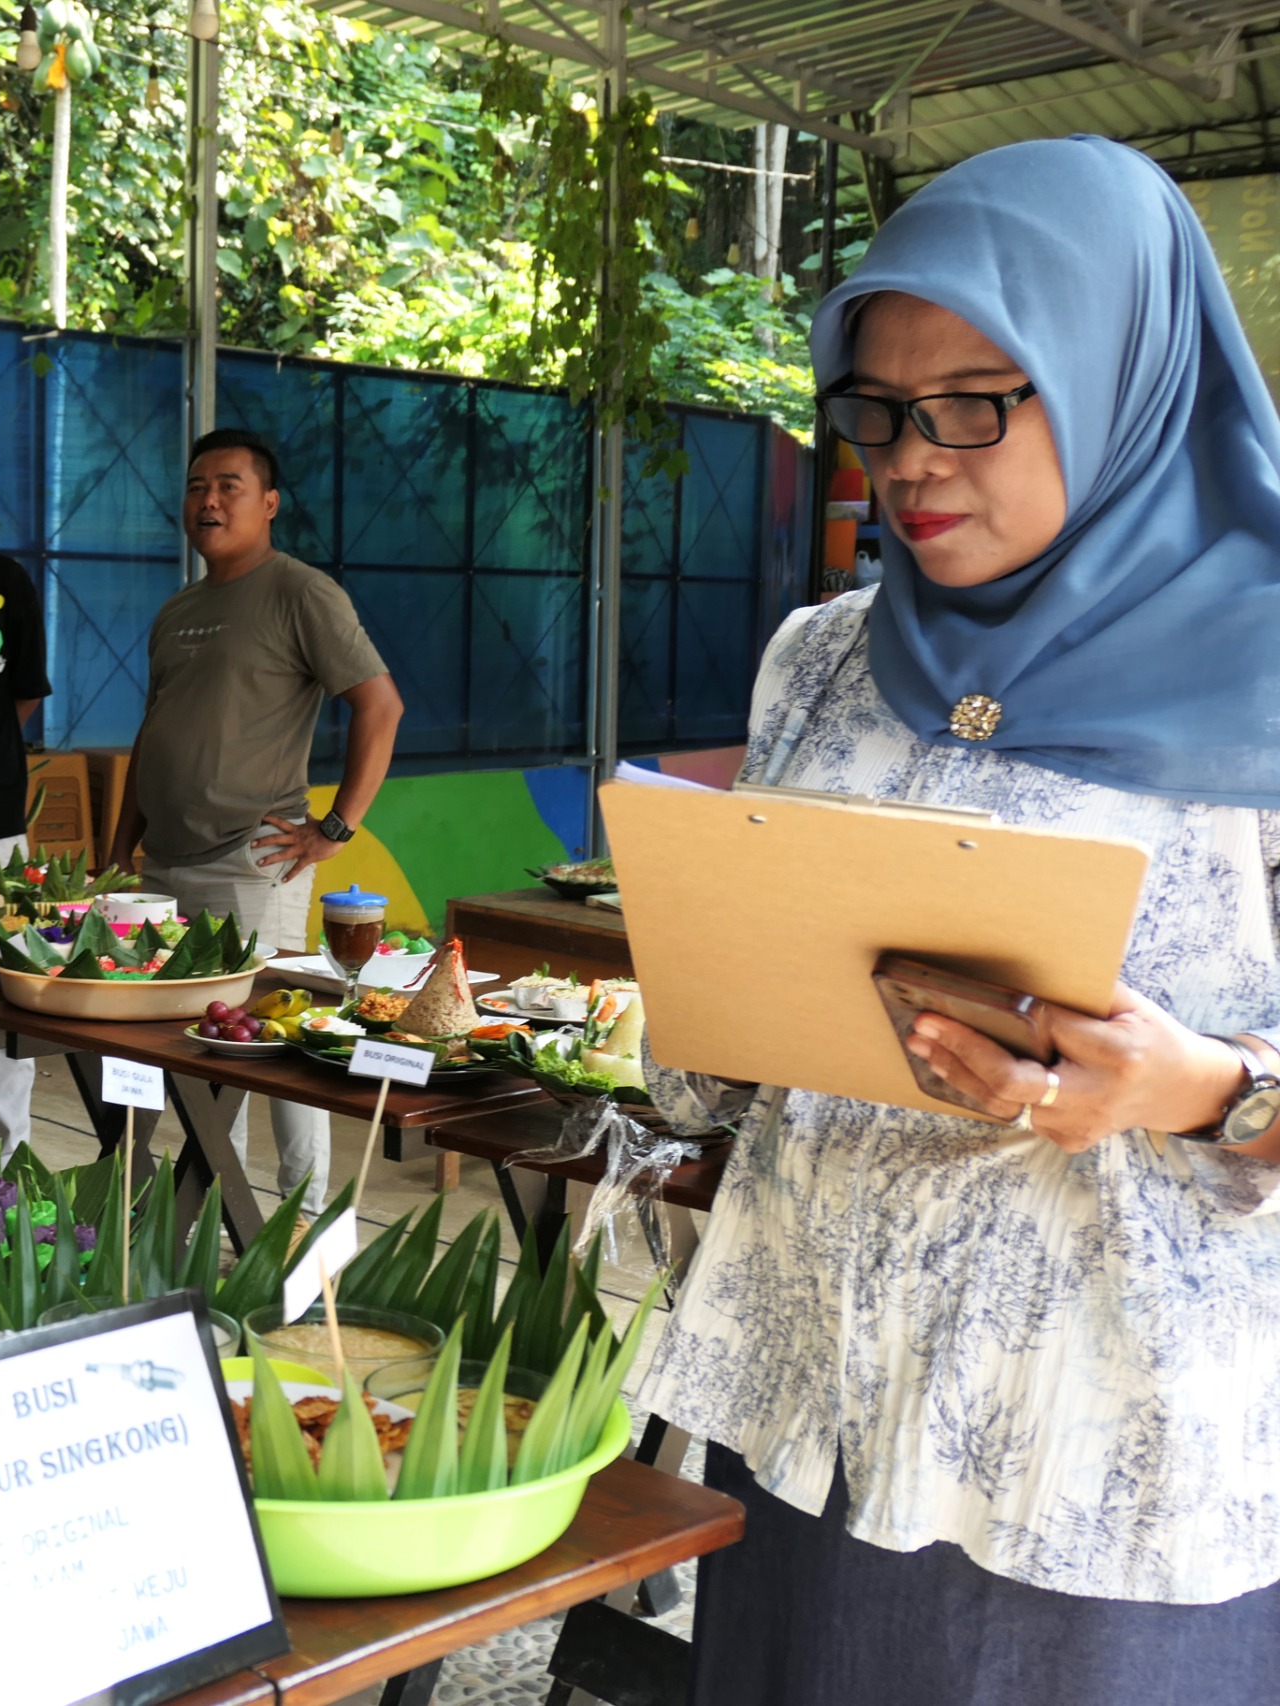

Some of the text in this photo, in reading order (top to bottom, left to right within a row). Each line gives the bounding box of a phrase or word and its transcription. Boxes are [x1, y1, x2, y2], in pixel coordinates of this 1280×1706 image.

[363, 1050, 425, 1071] BUSI ORIGINAL
[12, 1377, 80, 1419] BUSI
[39, 1412, 189, 1480] SINGKONG)
[21, 1505, 131, 1557] ORIGINAL
[133, 1565, 189, 1601] KEJU
[117, 1614, 170, 1652] JAWA
